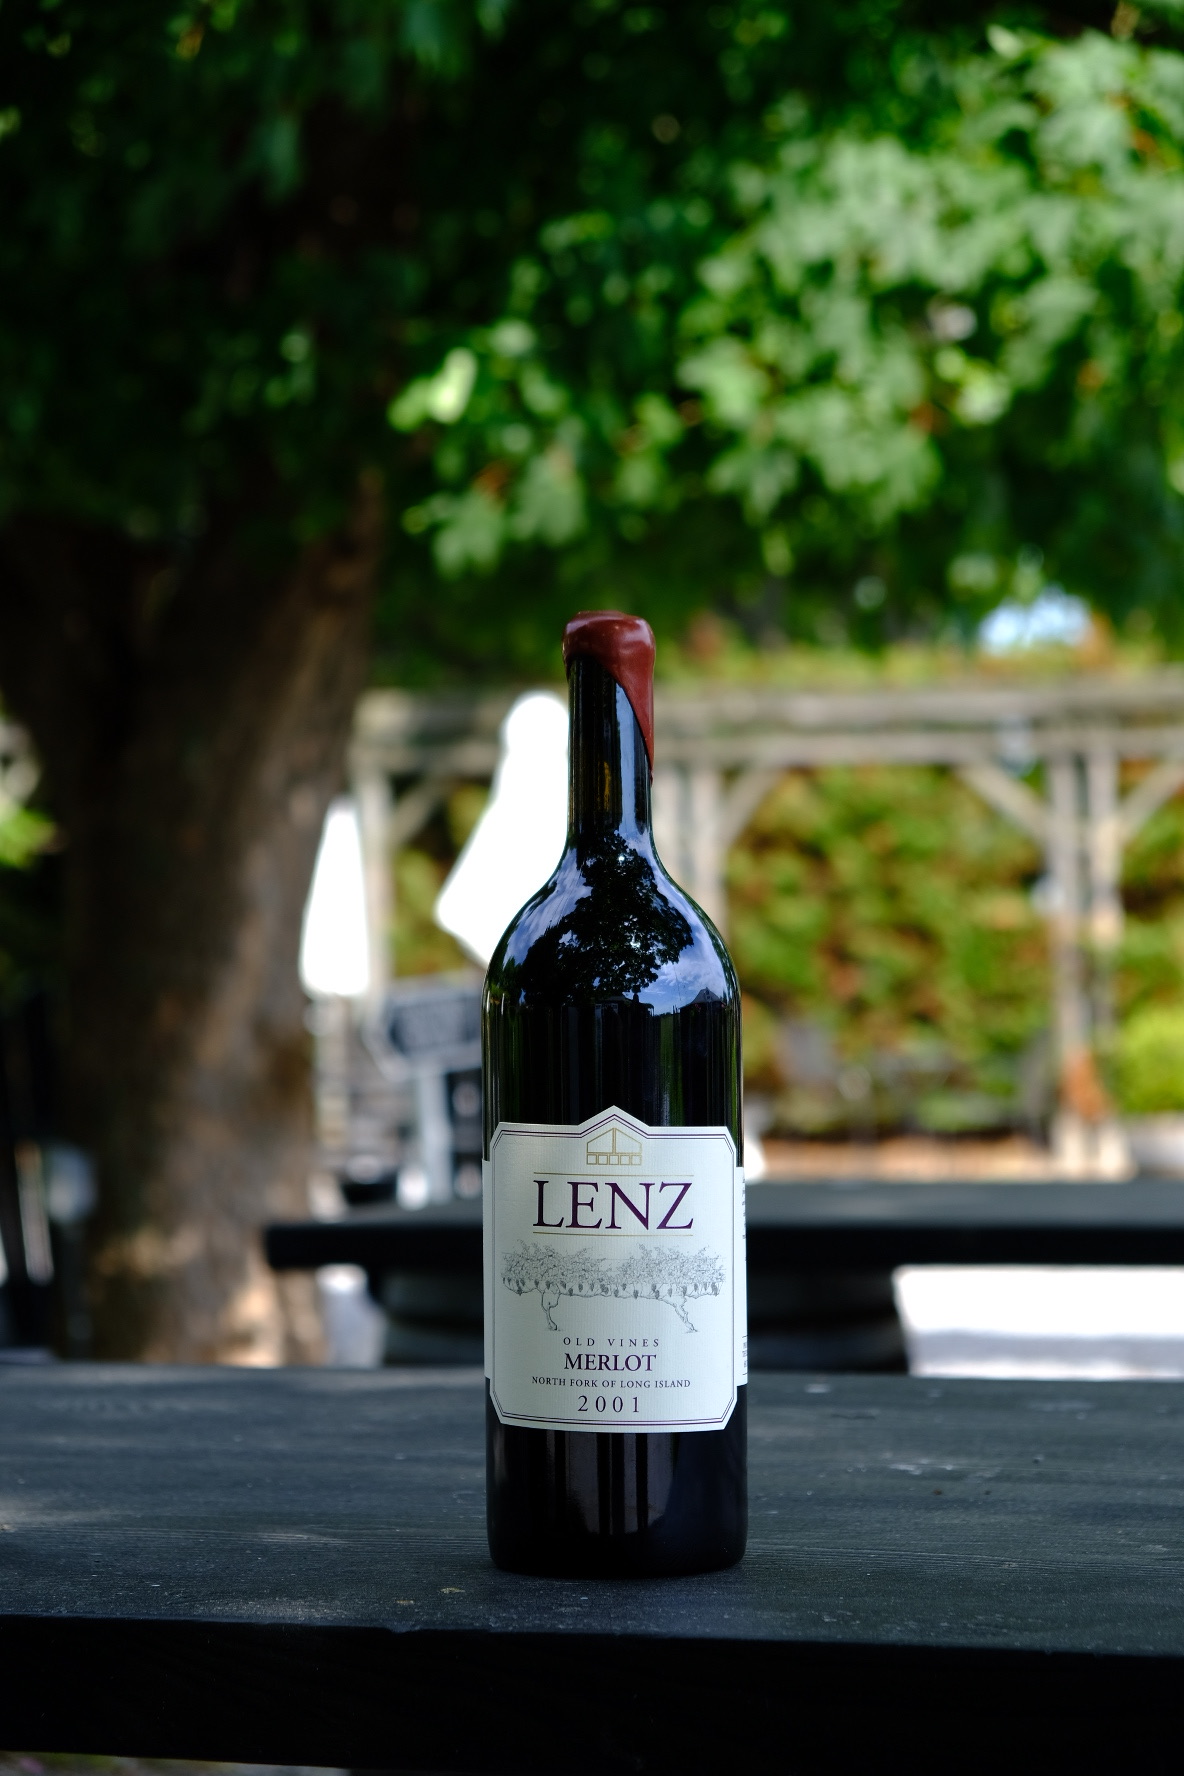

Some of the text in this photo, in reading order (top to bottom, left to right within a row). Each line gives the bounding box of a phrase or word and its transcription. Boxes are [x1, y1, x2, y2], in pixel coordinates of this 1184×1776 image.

[533, 1180, 694, 1230] LENZ
[563, 1337, 659, 1347] OLD VINES
[564, 1353, 657, 1371] MERLOT
[532, 1376, 690, 1388] NORTH FORK OF LONG ISLAND
[577, 1395, 640, 1413] 2001
